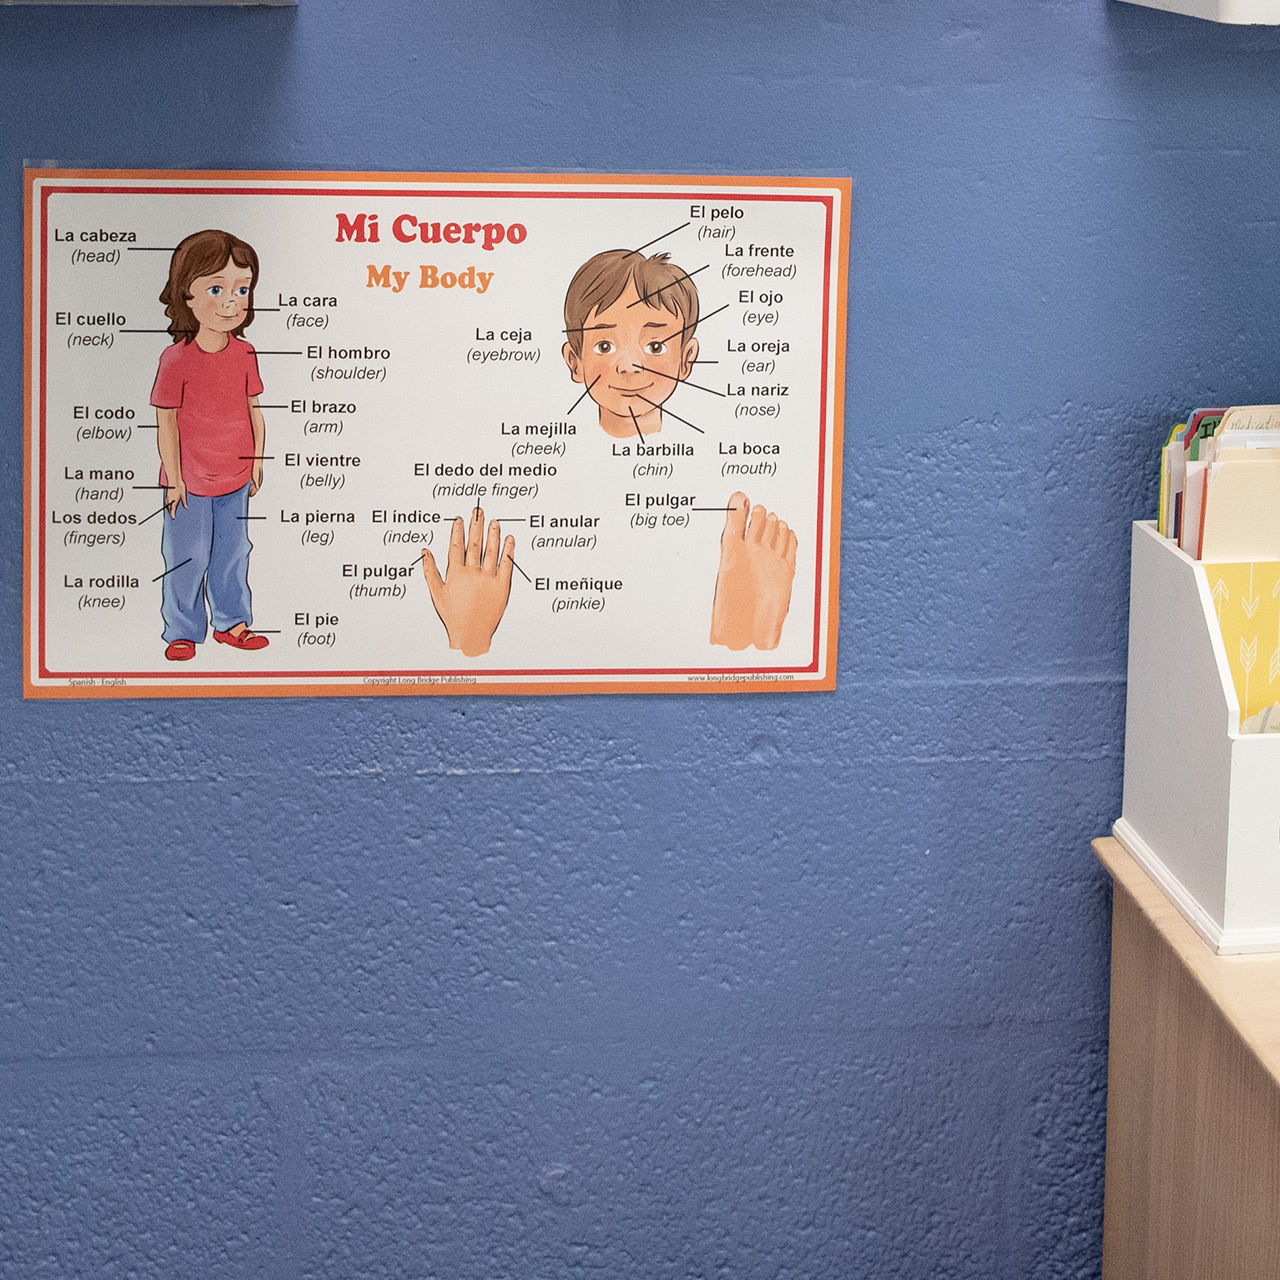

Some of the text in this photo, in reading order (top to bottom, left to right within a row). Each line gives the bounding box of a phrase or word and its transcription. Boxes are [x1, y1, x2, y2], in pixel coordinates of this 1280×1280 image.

[688, 205, 745, 222] El pelo
[54, 228, 137, 243] La cabeza
[335, 213, 527, 251] Mi Cuerpo
[697, 224, 736, 242] (hair)
[71, 248, 121, 266] (head)
[725, 243, 795, 258] La frente
[366, 265, 494, 294] My Body
[721, 262, 797, 281] (forehead)
[278, 293, 338, 308] La cara
[738, 289, 784, 307] El ojo
[55, 311, 127, 326] El cuello
[286, 313, 329, 331] (face)
[742, 309, 780, 327] (eye)
[67, 332, 115, 350] (neck)
[475, 327, 532, 345] La ceja
[307, 345, 391, 360] El hombro
[466, 347, 541, 364] (eyebrow)
[727, 339, 790, 356] La oreja
[310, 365, 387, 383] (shoulder)
[741, 358, 776, 376] (ear)
[725, 383, 789, 398] La nariz
[73, 405, 136, 420] El codo
[291, 399, 357, 414] El brazo
[734, 402, 781, 419] (nose)
[76, 425, 132, 443] (elbow)
[303, 419, 344, 437] (arm)
[501, 421, 577, 439] La mejilla
[511, 441, 567, 458] (cheek)
[612, 442, 695, 458] La barbilla
[718, 441, 780, 455] La boca
[284, 453, 361, 467] El vientre
[64, 466, 135, 481] La mano
[414, 462, 558, 477] El dedo del medio
[632, 462, 674, 480] (chin)
[721, 461, 777, 478] (mouth)
[299, 473, 346, 490] (belly)
[74, 486, 124, 503] (hand)
[432, 482, 539, 501] (middle finger)
[625, 493, 698, 512] El pulgar
[51, 510, 139, 525] Los dedos
[280, 509, 355, 526] La pierna
[372, 507, 442, 524] El índice
[529, 514, 601, 528] El anular
[630, 512, 690, 530] (big toe)
[63, 530, 126, 548] (fingers)
[301, 529, 335, 547] (leg)
[382, 529, 434, 547] (index)
[531, 534, 597, 551] (annular)
[342, 563, 415, 582] El pulgar
[64, 574, 140, 589] La rodilla
[535, 577, 623, 594] El meñique
[349, 583, 407, 601] (thumb)
[77, 594, 126, 611] (knee)
[551, 596, 606, 614] (pinkie)
[294, 612, 339, 629] El pie
[297, 631, 336, 648] (foot)
[688, 674, 794, 682] www.longbridgepublishing.com
